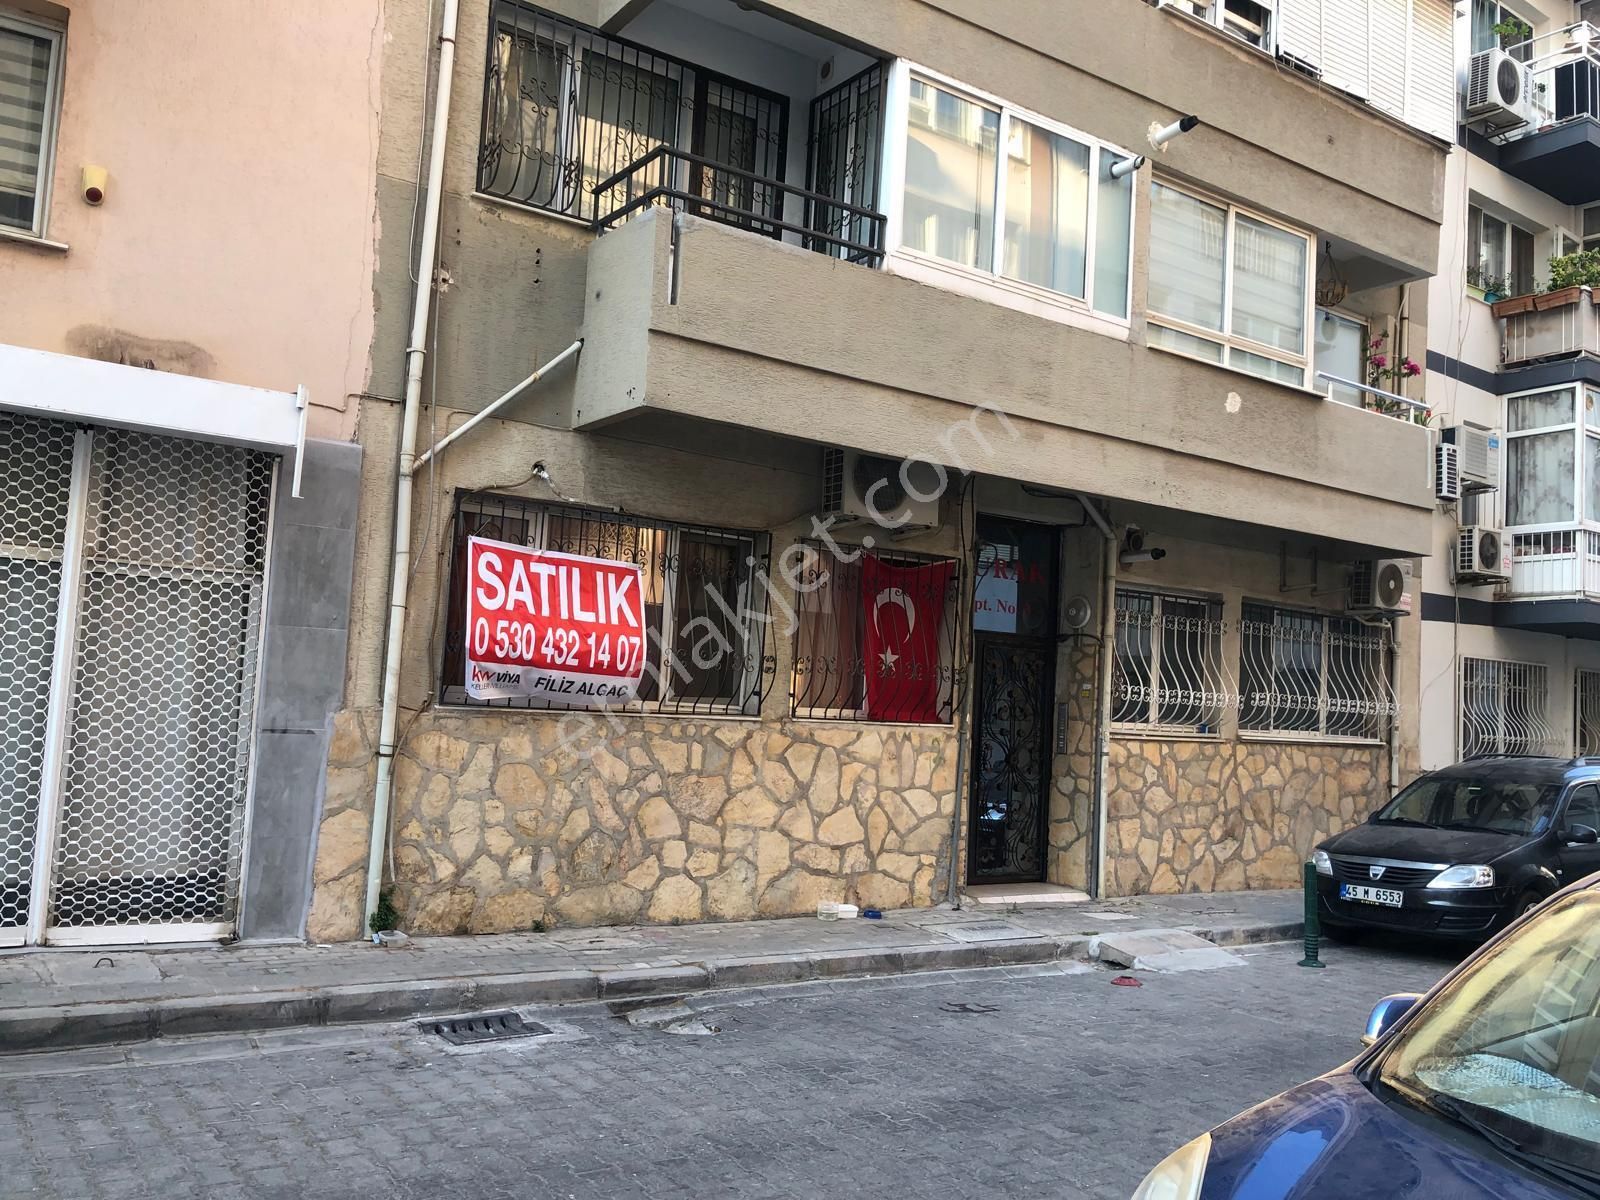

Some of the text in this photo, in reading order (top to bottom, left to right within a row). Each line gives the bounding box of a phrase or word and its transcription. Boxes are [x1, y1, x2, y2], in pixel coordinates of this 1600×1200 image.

[476, 551, 639, 628] SATILIK
[974, 599, 992, 614] pt.
[474, 616, 641, 672] 0 530 432 14 07
[496, 669, 521, 684] VİYA
[533, 674, 573, 694] FİLİZ
[1346, 886, 1358, 897] 45
[1363, 888, 1370, 899] M
[1375, 889, 1403, 904] 6553
